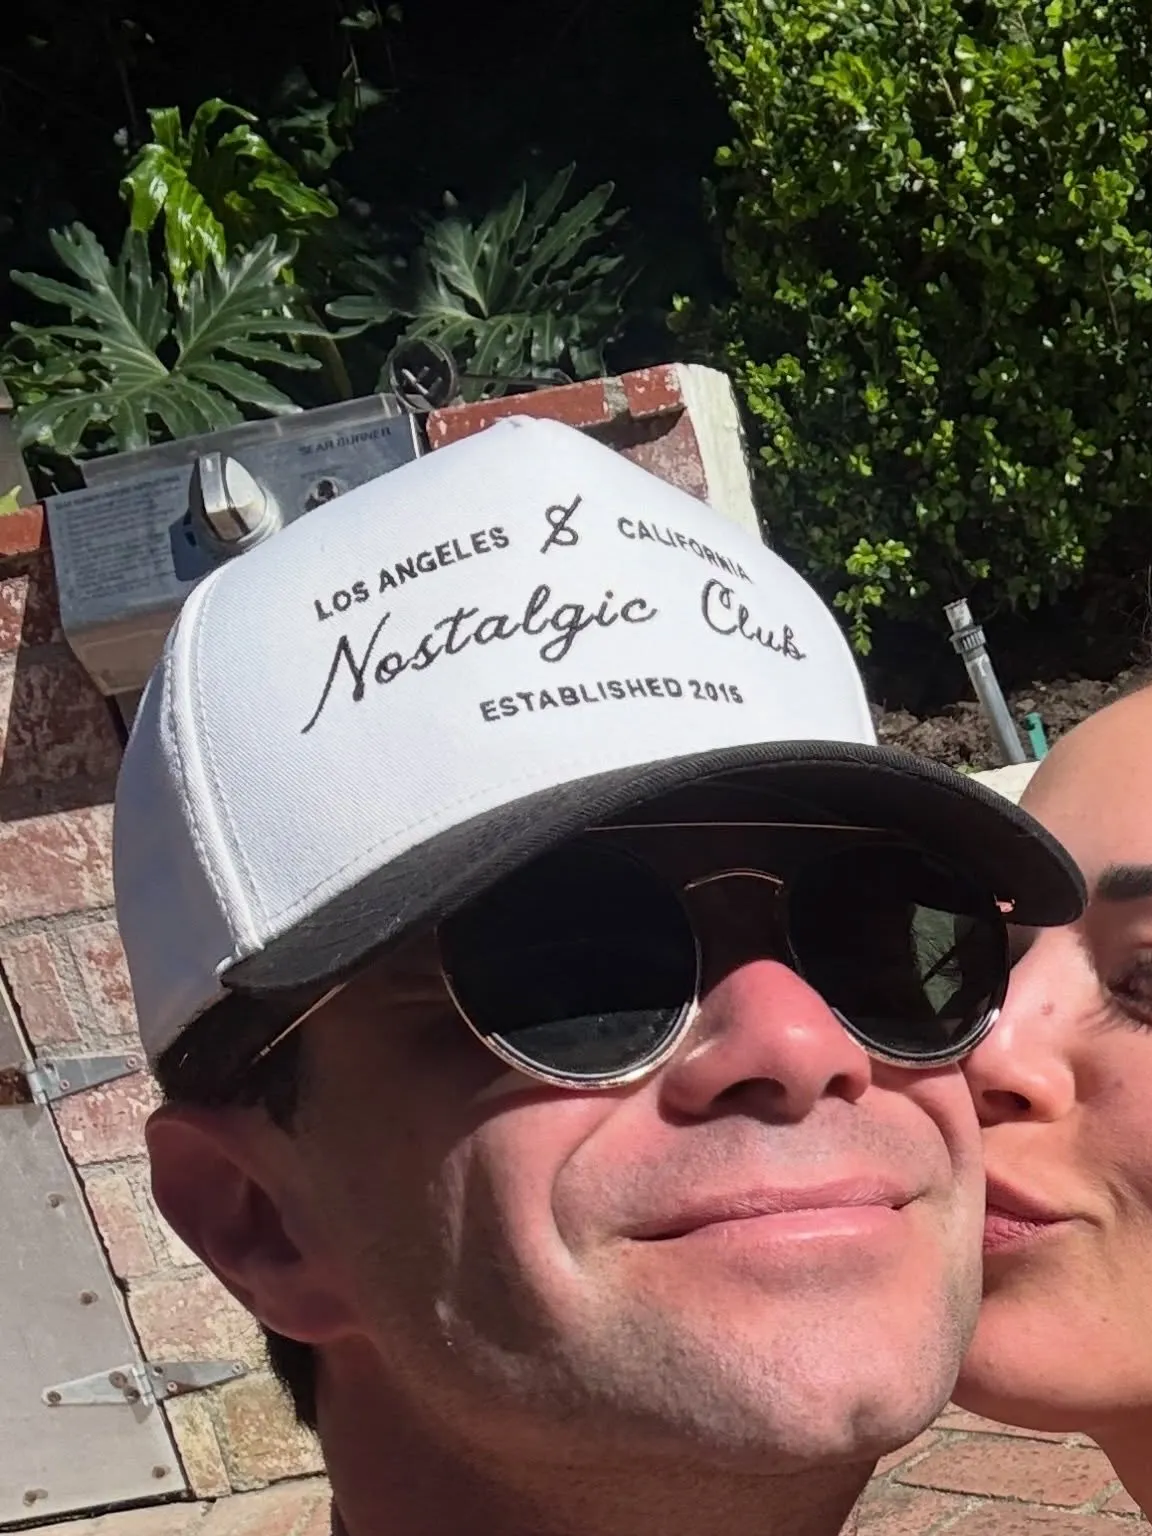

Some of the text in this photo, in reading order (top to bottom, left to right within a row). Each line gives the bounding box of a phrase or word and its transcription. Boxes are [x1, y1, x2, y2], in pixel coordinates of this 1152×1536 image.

[313, 580, 371, 622] LOS
[378, 525, 510, 594] ANGELES
[616, 515, 755, 585] CALIFORNIA
[300, 577, 807, 735] Nostalgic Club
[478, 676, 744, 723] ESTABLISHED 2015
